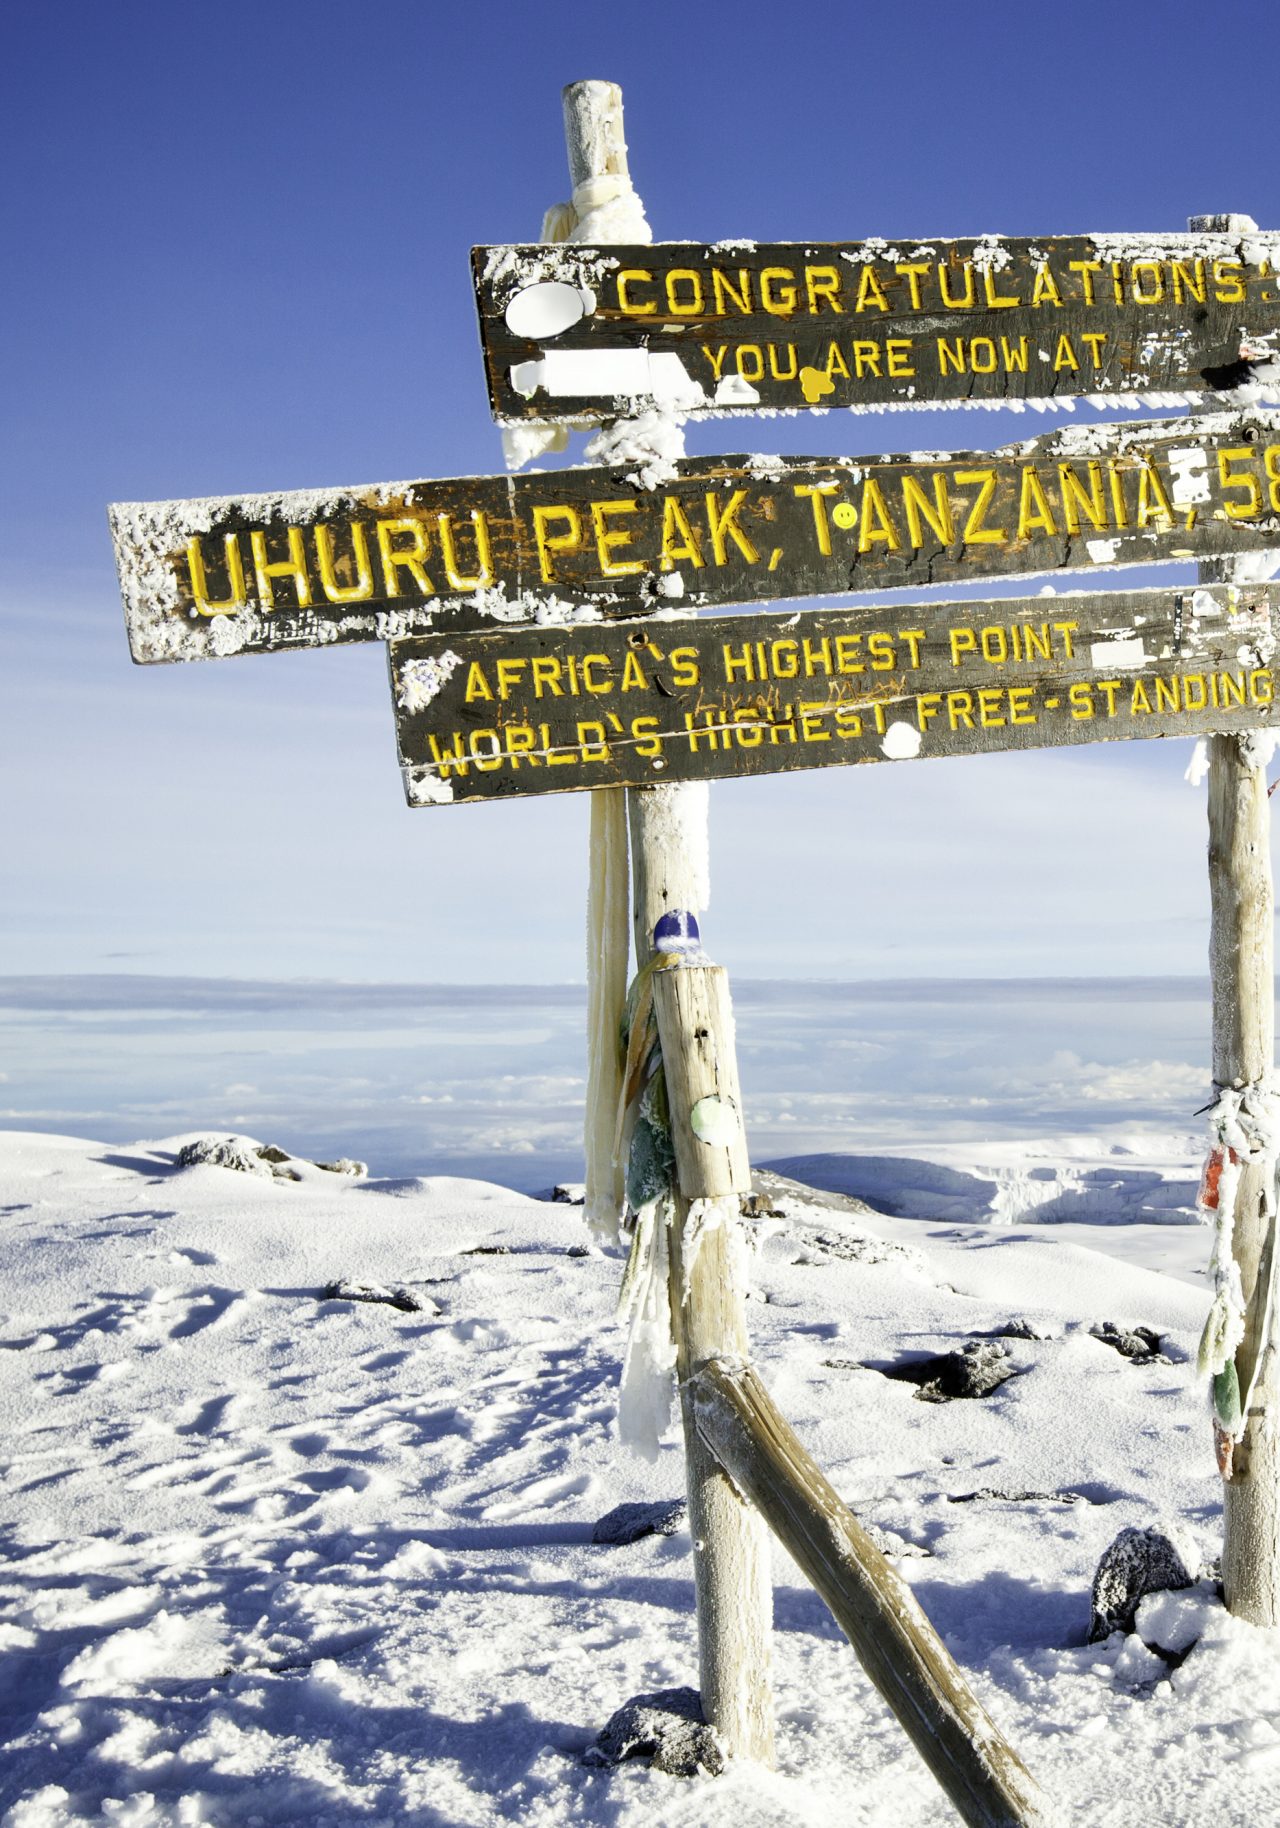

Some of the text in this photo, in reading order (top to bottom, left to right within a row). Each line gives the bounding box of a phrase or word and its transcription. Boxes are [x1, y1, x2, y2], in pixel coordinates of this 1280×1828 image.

[617, 258, 1271, 316] CONGRATULATIONS!
[702, 333, 1107, 382] YOU ARE NOW AT
[186, 508, 497, 617] UHURU
[532, 485, 784, 584] PEAK,
[794, 453, 1198, 556] TANZANIA,
[724, 630, 926, 683] HIGHEST
[950, 621, 1080, 667] POINT
[685, 695, 891, 753] HIGHEST
